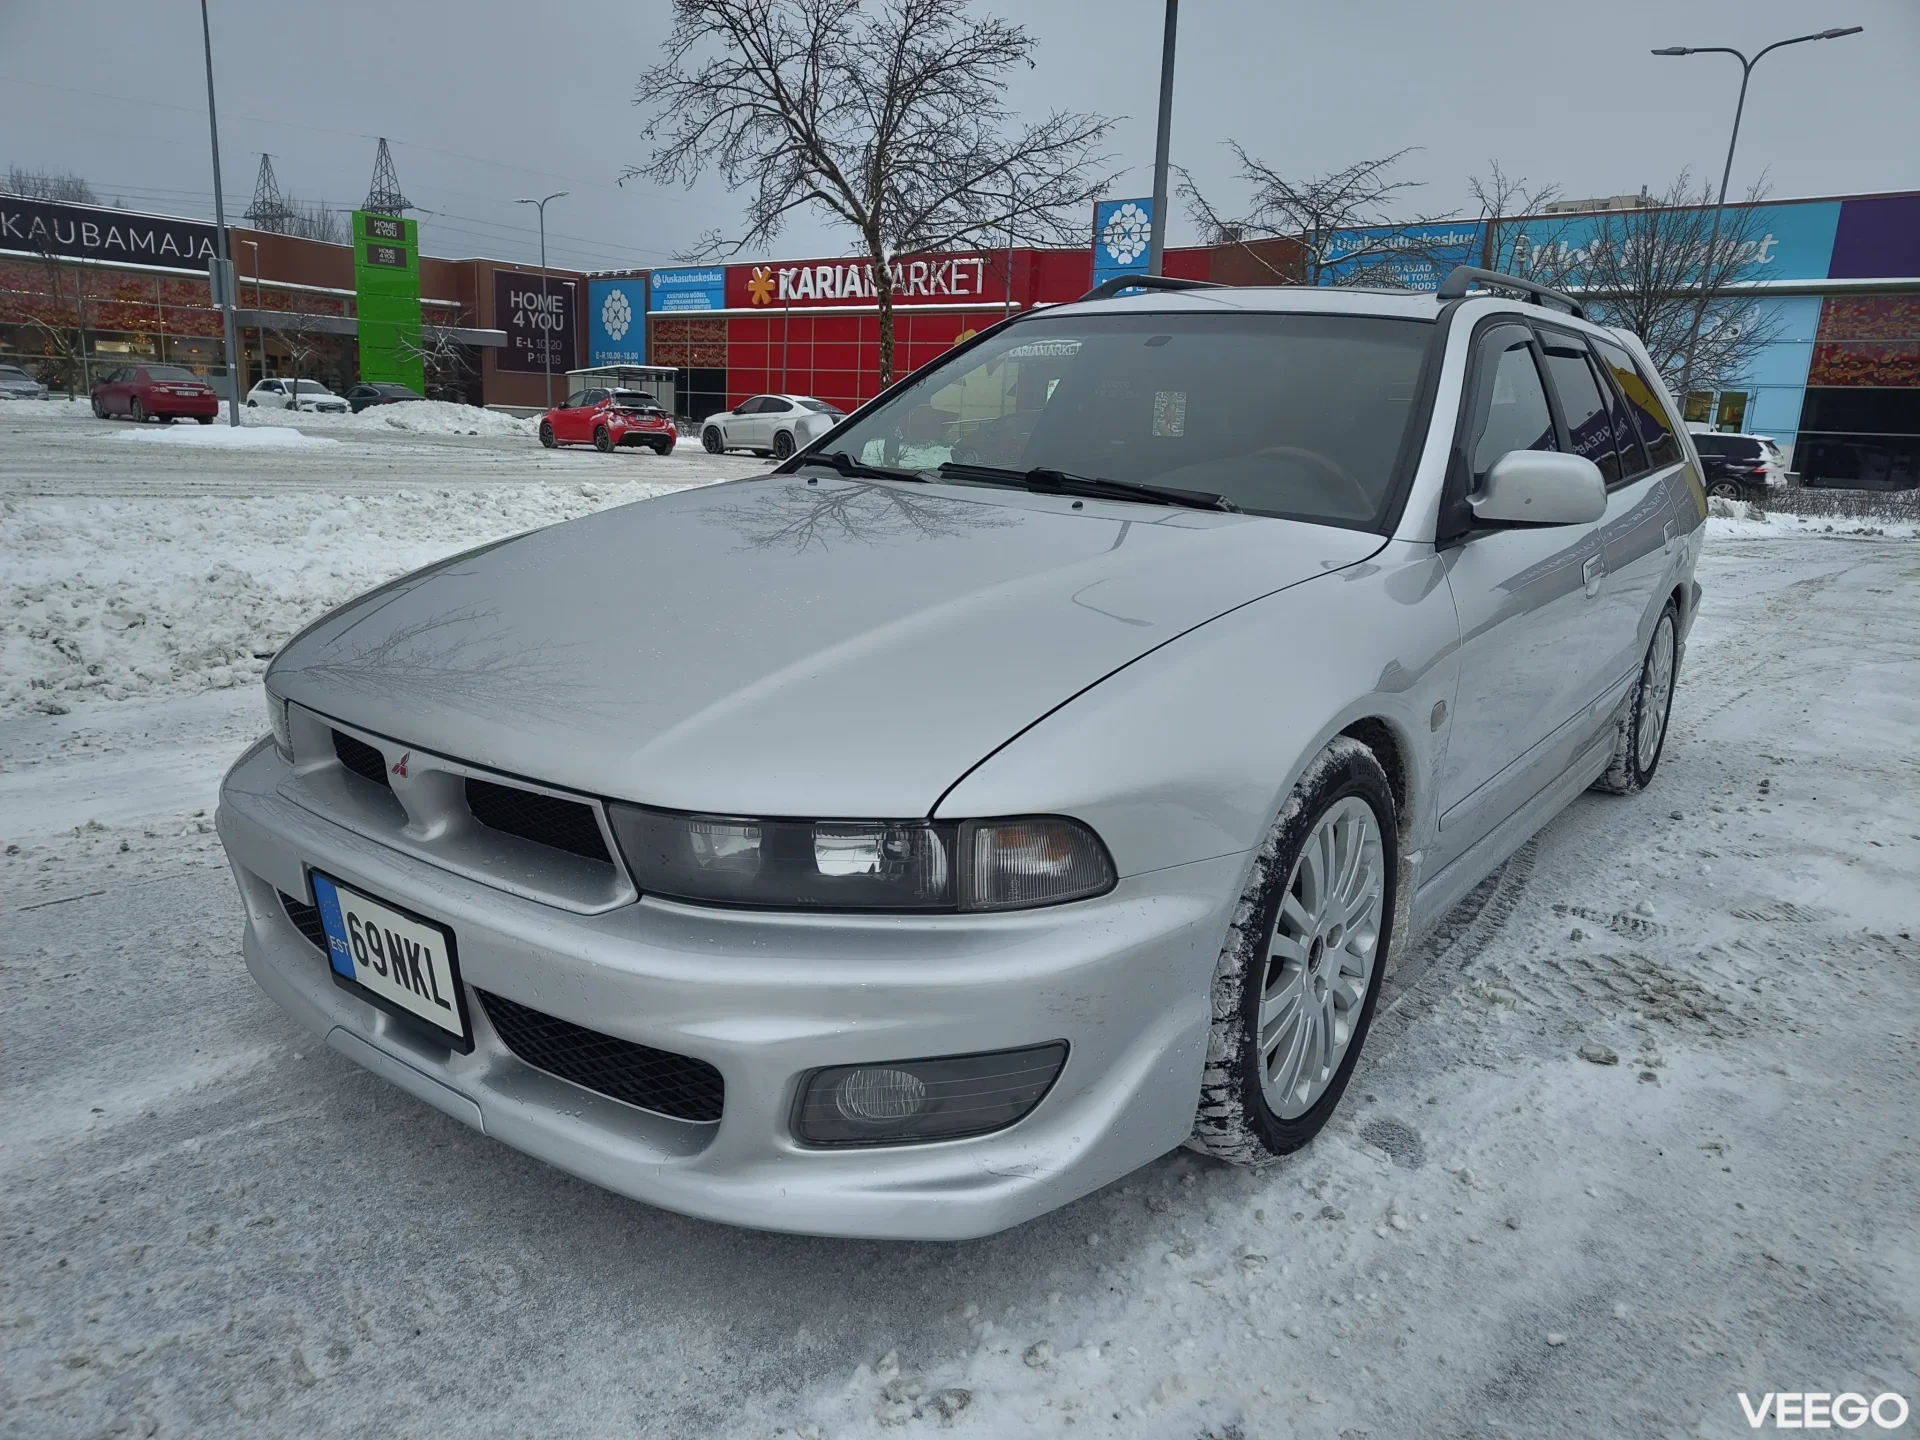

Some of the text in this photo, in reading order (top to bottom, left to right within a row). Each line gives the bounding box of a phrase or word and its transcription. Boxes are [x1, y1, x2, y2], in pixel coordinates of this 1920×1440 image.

[1, 211, 217, 260] KAUBAMAJA
[374, 220, 396, 230] HOME
[661, 271, 722, 284] Uuskasutuskeskus
[510, 290, 564, 313] HOME
[512, 310, 564, 331] 4 YOU
[516, 336, 533, 348] E-L
[528, 352, 534, 362] P
[329, 935, 349, 957] EST
[347, 911, 452, 1012] 69NKL
